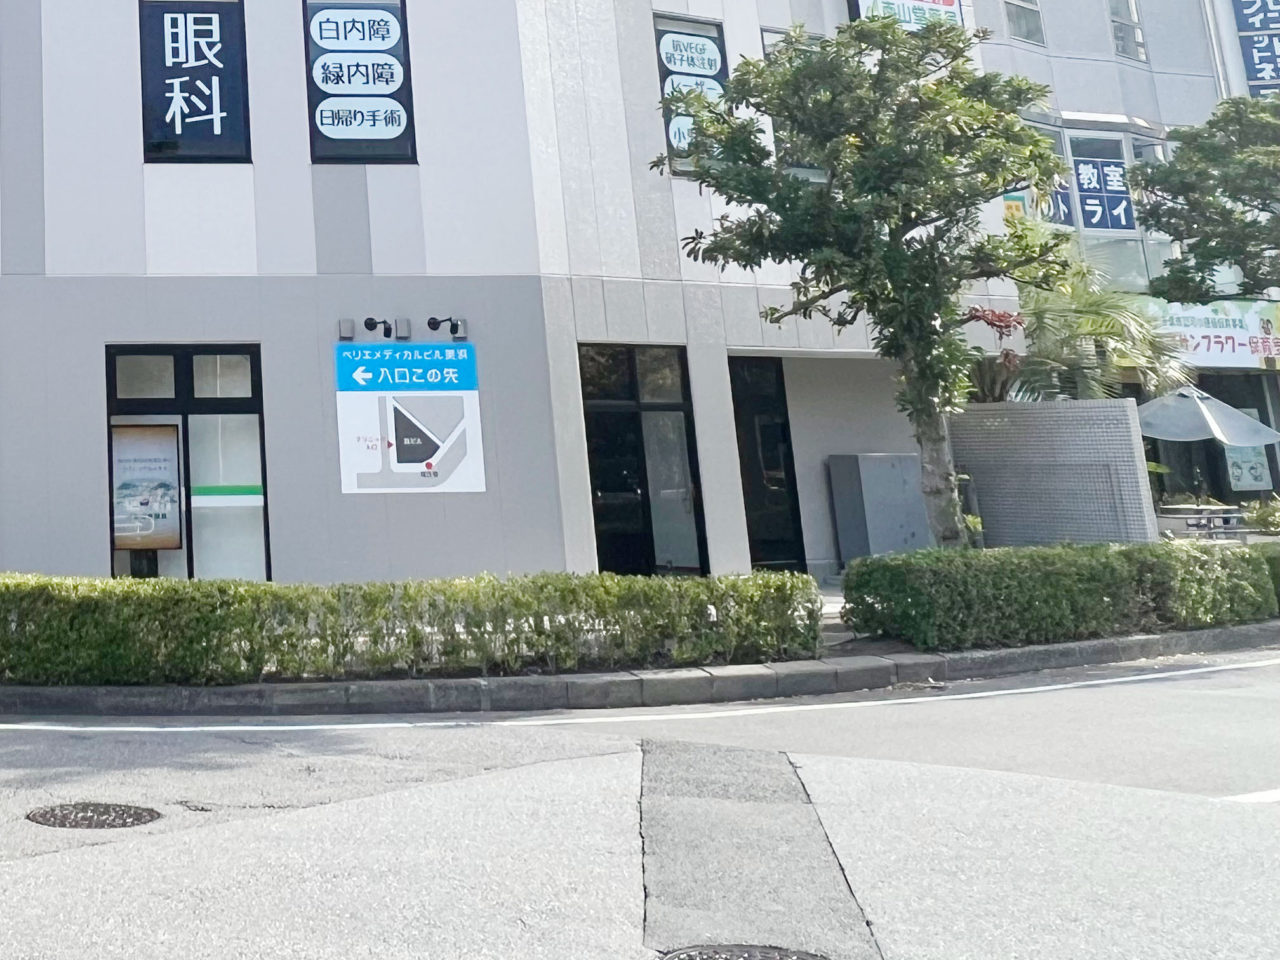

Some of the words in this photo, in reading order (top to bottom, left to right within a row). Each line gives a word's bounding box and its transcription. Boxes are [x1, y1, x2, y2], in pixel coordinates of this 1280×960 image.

[318, 19, 391, 41] 白内障
[164, 13, 227, 135] 眼科
[321, 62, 396, 86] 緑内障
[320, 109, 402, 127] 日帰り手術
[378, 368, 459, 383] 入口この先
